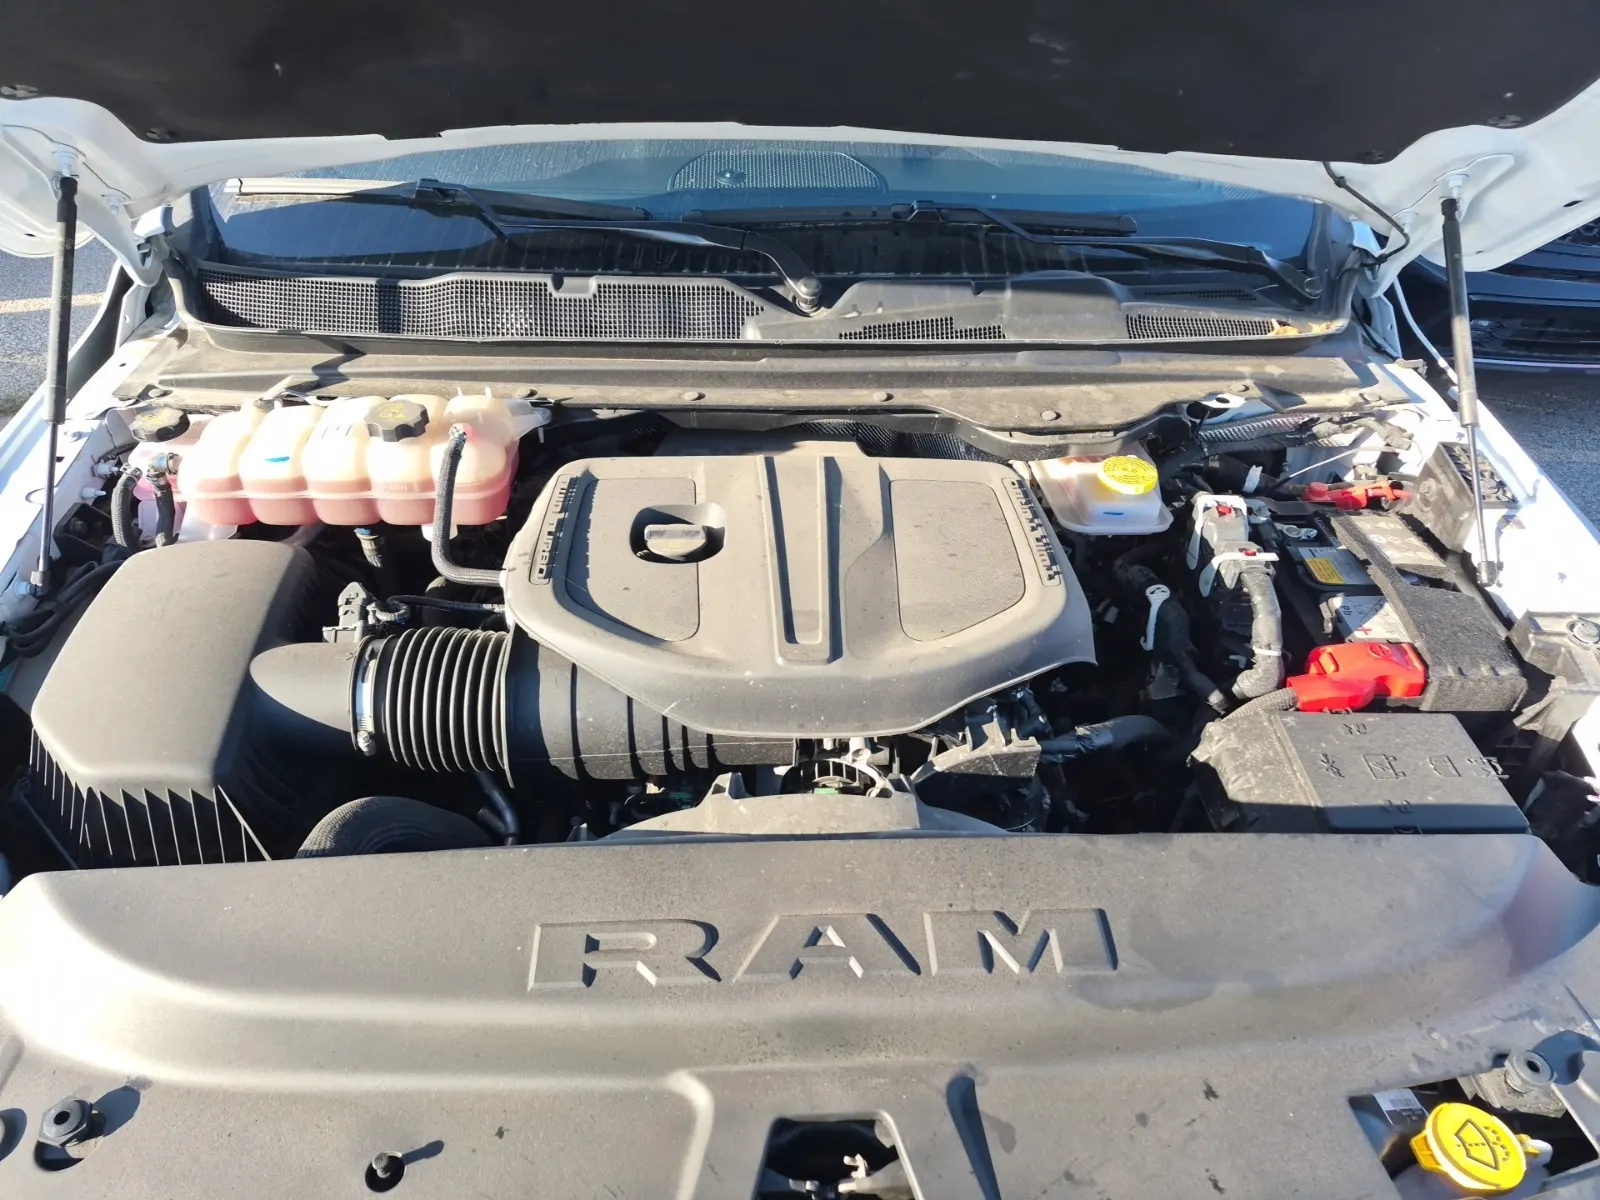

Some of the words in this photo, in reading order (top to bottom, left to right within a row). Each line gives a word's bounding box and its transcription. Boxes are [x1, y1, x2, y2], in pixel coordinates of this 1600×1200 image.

[1010, 480, 1042, 533] TURBO
[536, 519, 559, 580] TURBO
[526, 907, 1119, 991] RAM
